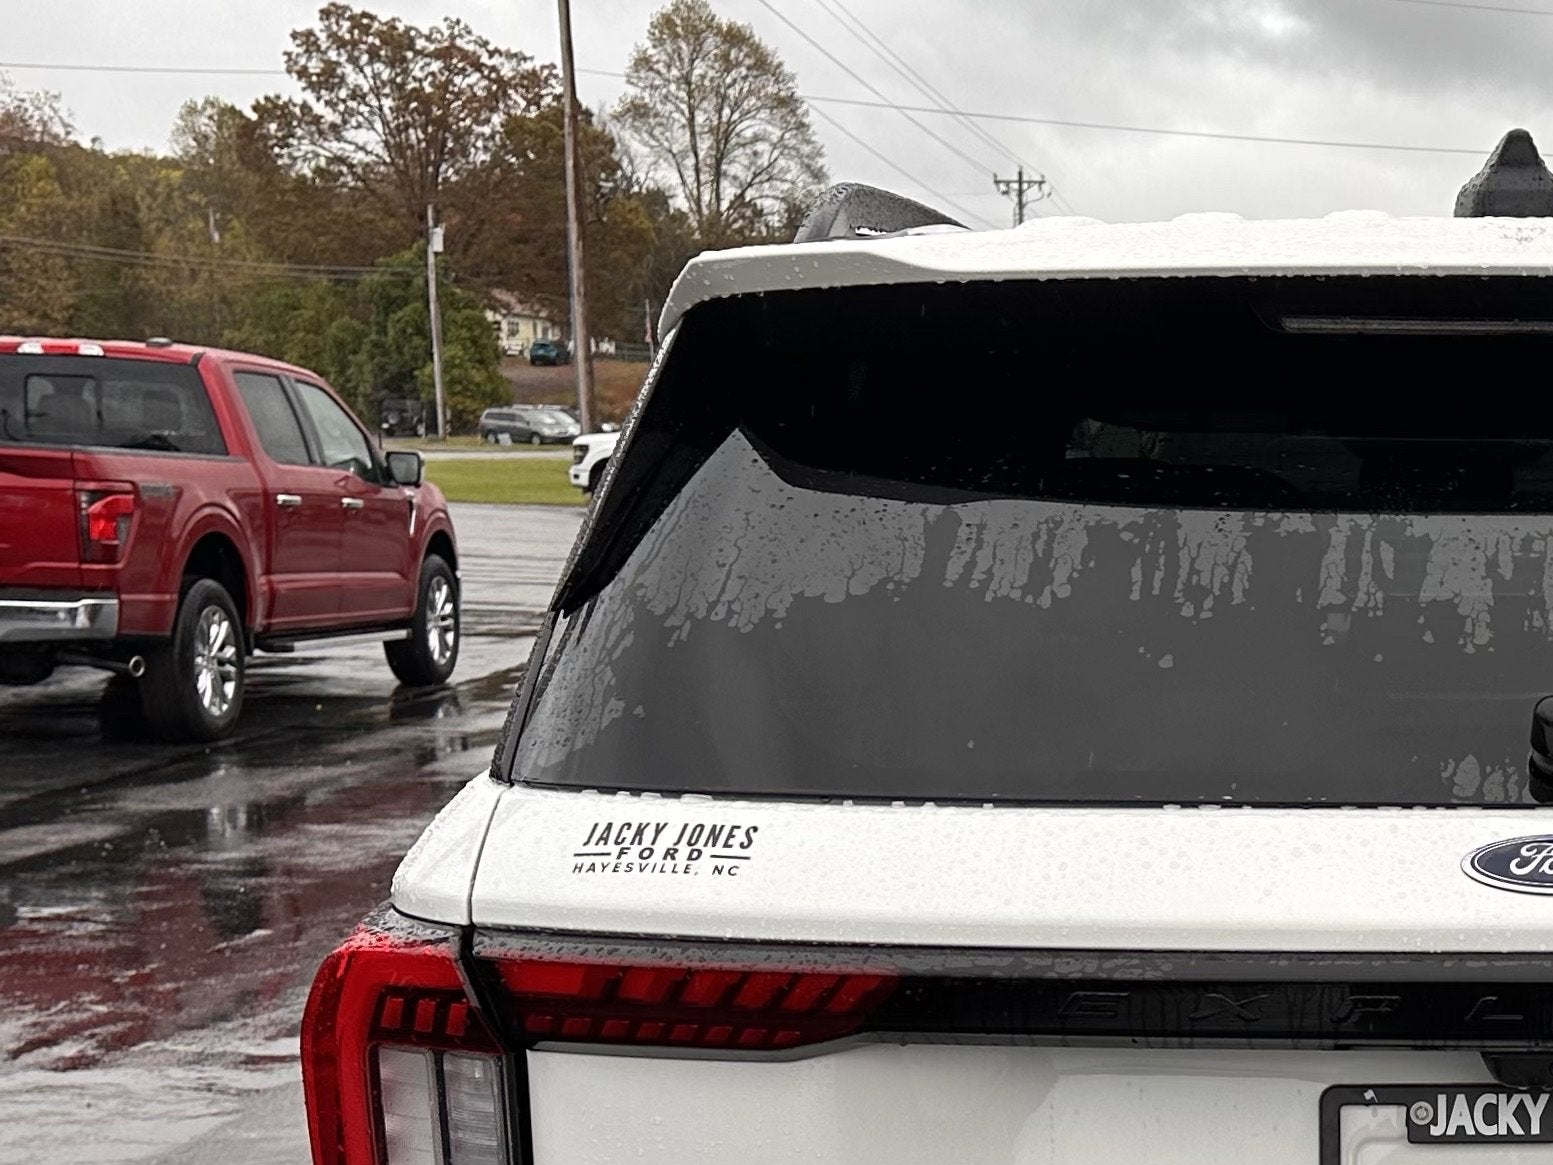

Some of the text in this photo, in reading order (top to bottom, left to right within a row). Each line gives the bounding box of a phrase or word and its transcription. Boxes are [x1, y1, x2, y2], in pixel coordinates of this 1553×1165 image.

[582, 821, 759, 850] JACKY JONES
[615, 847, 704, 861] FORD
[572, 862, 740, 877] HAYESVILLE, NC
[1429, 1092, 1550, 1137] JACKY
